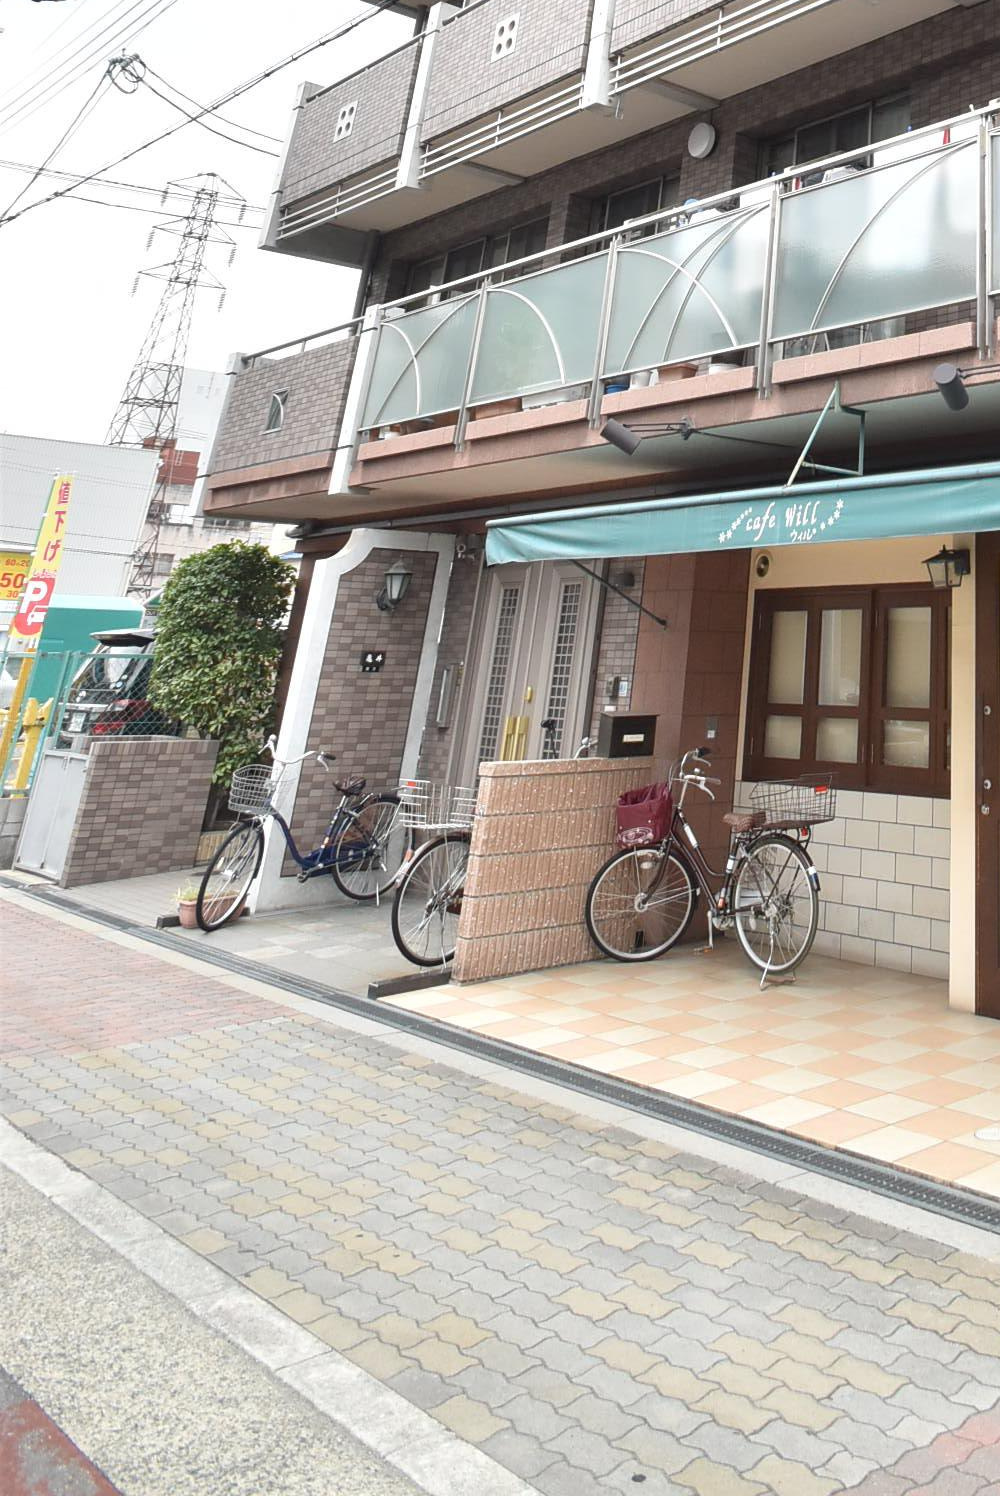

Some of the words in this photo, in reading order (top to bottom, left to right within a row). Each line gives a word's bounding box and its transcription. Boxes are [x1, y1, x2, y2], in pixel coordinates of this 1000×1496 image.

[43, 481, 71, 562] 値下げ
[745, 502, 776, 542] cafe
[785, 501, 820, 527] Will
[790, 528, 813, 543] ウィル
[19, 580, 48, 614] P
